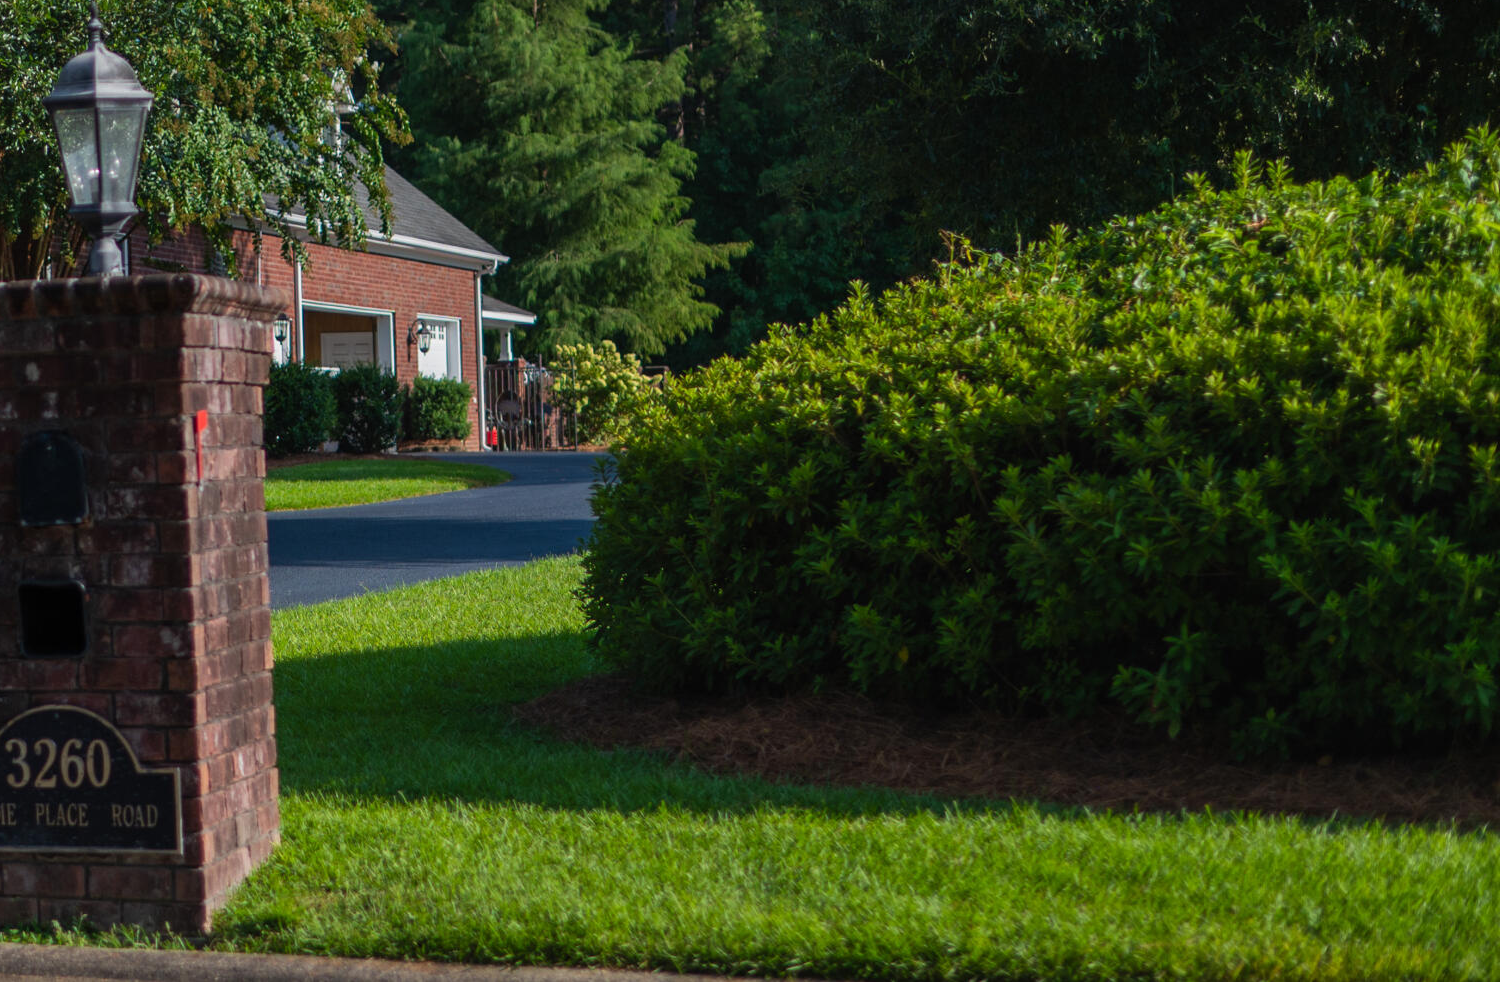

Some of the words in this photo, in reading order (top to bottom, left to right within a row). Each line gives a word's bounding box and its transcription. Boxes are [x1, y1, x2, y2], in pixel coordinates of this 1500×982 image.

[4, 738, 112, 789] 3260
[34, 803, 89, 827] PLACE
[111, 804, 159, 828] ROAD
